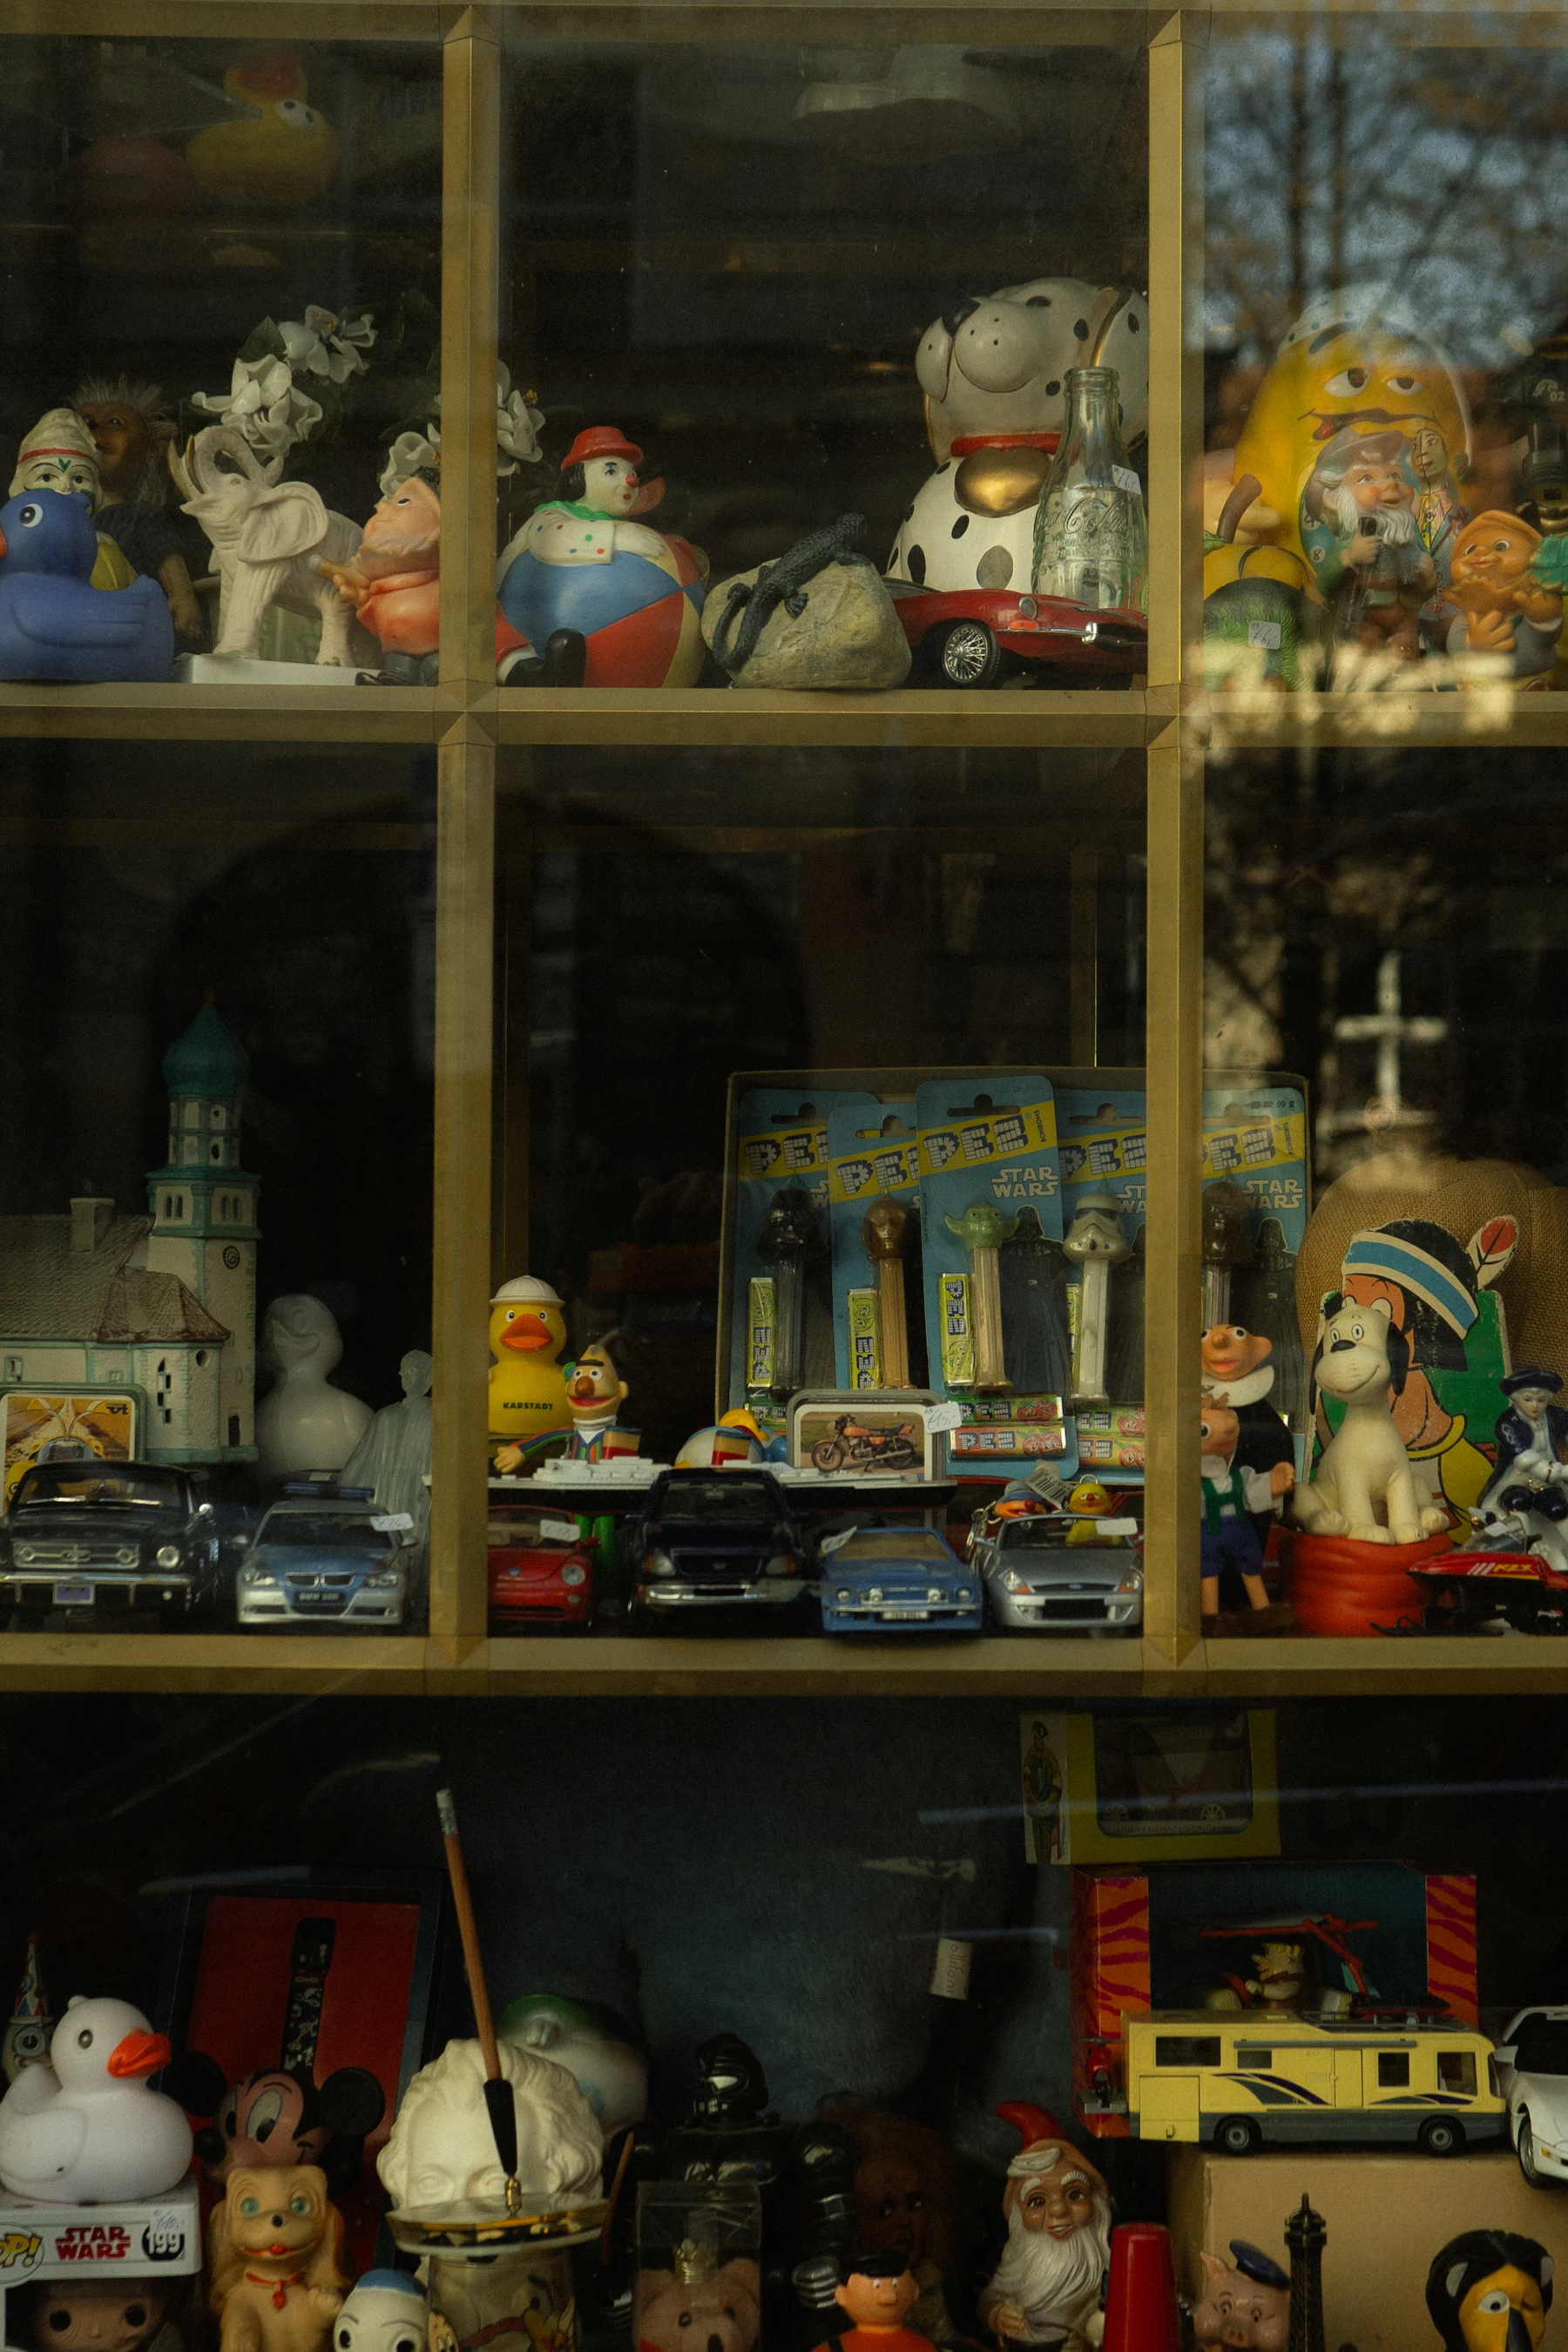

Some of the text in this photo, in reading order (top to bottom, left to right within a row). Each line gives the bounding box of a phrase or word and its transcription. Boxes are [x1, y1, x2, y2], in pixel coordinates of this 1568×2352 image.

[1313, 548, 1322, 560] 8
[923, 1114, 1029, 1169] PEZ
[1202, 1126, 1275, 1172] EZ
[990, 1166, 1058, 1184] STAR
[992, 1180, 1058, 1200] WARS
[1242, 1179, 1303, 1194] STAR
[946, 1279, 967, 1336] PEZ
[752, 1326, 773, 1382] PEZ
[855, 1335, 876, 1389] PEZ
[503, 1402, 553, 1410] KARSTADT
[959, 1430, 1017, 1450] PEZ
[55, 2226, 131, 2244] STAR
[145, 2230, 182, 2254] 199
[56, 2242, 131, 2261] WARS
